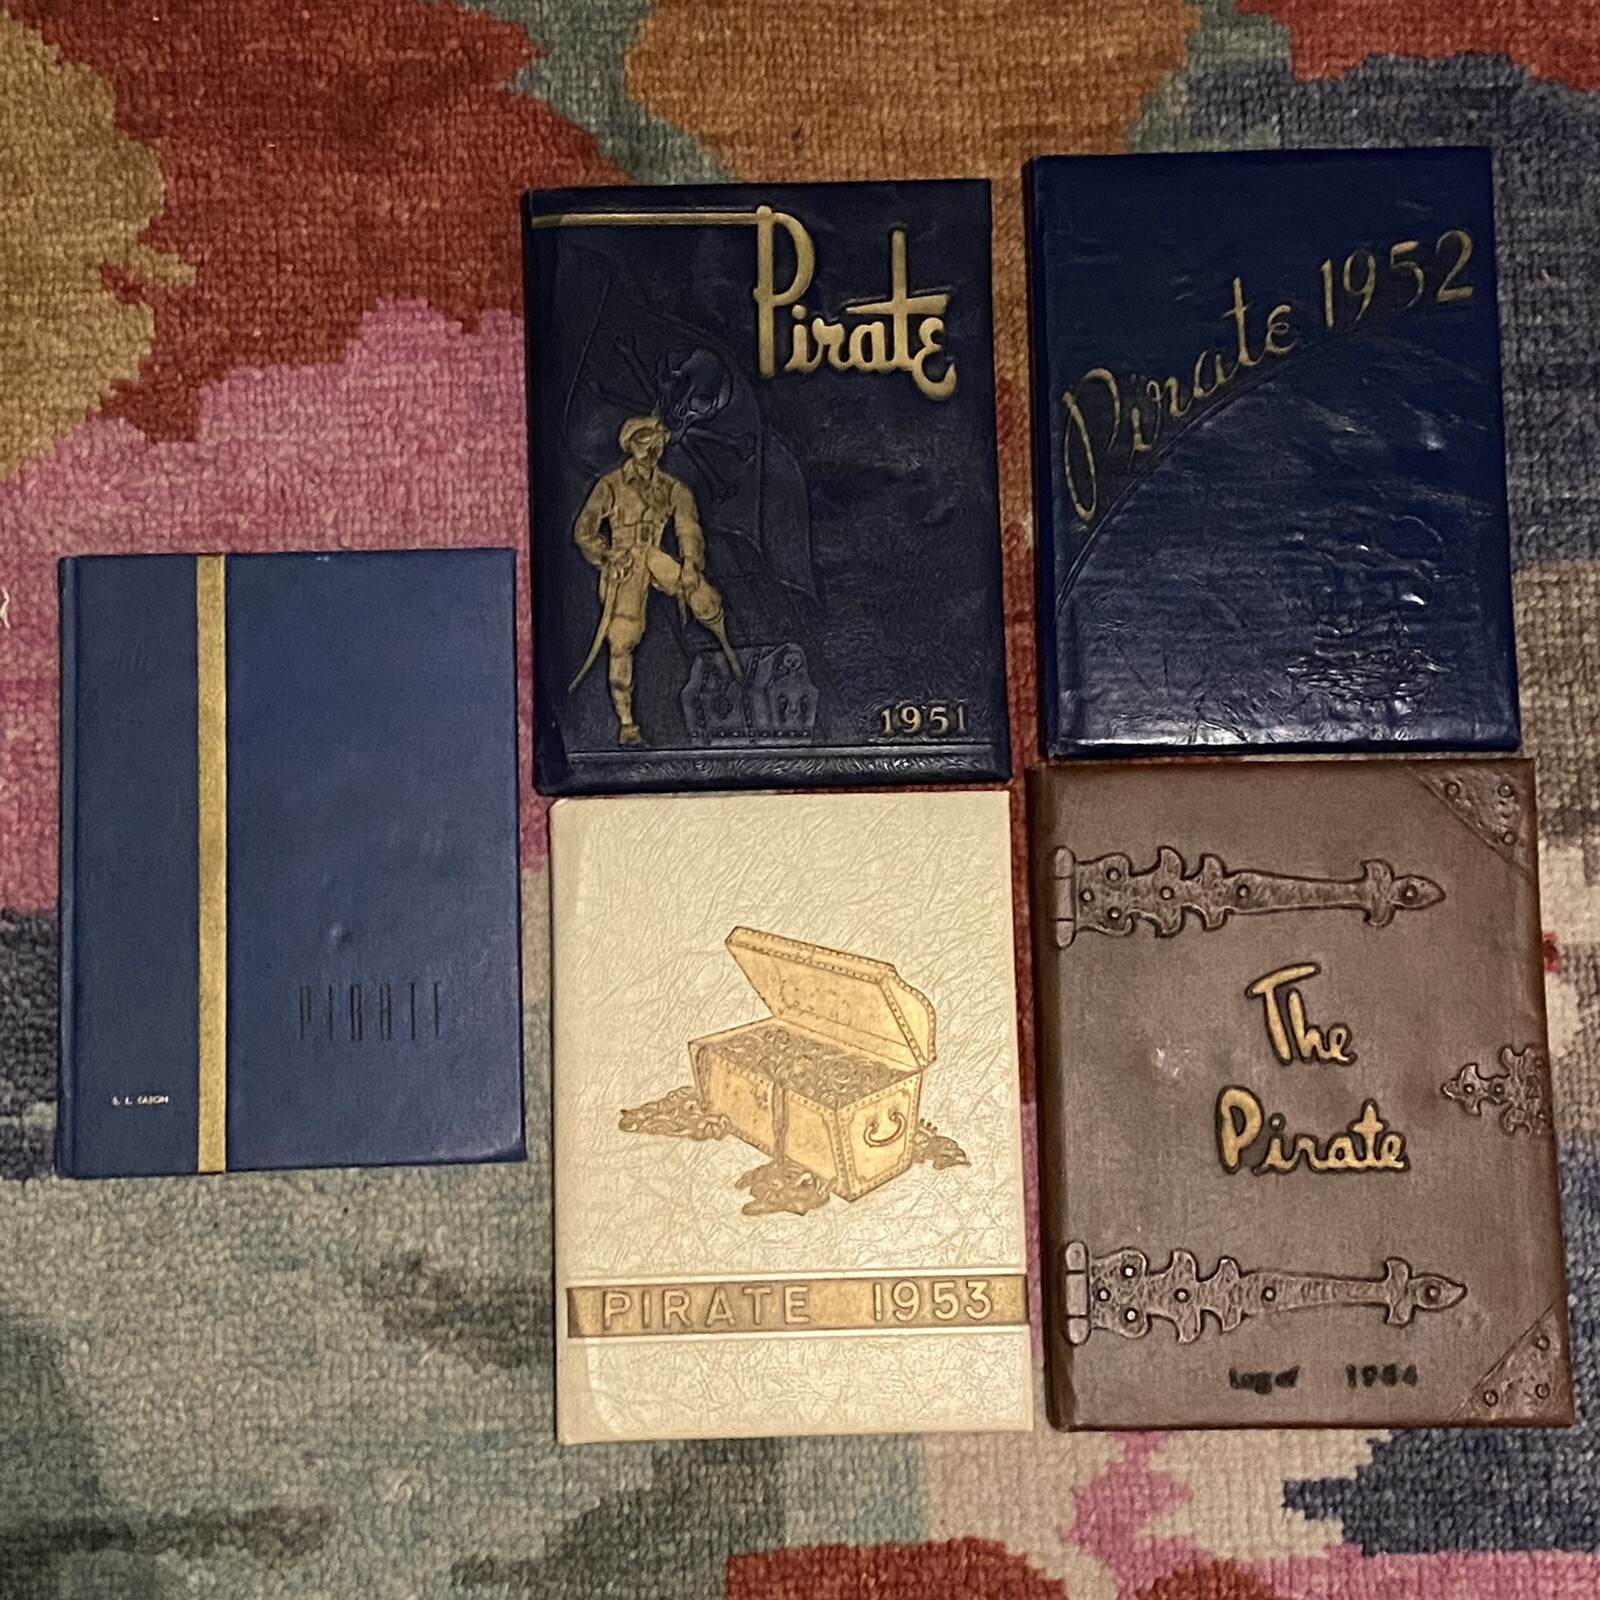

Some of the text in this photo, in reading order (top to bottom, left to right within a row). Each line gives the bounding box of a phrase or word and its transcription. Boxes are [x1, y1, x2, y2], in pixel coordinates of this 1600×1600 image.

[753, 204, 958, 402] Pirate
[1062, 229, 1475, 523] Pirate 1952
[881, 703, 968, 738] 1951
[1245, 961, 1358, 1066] The
[1214, 1085, 1411, 1175] Pirate
[602, 1280, 994, 1330] PIRATE 1953
